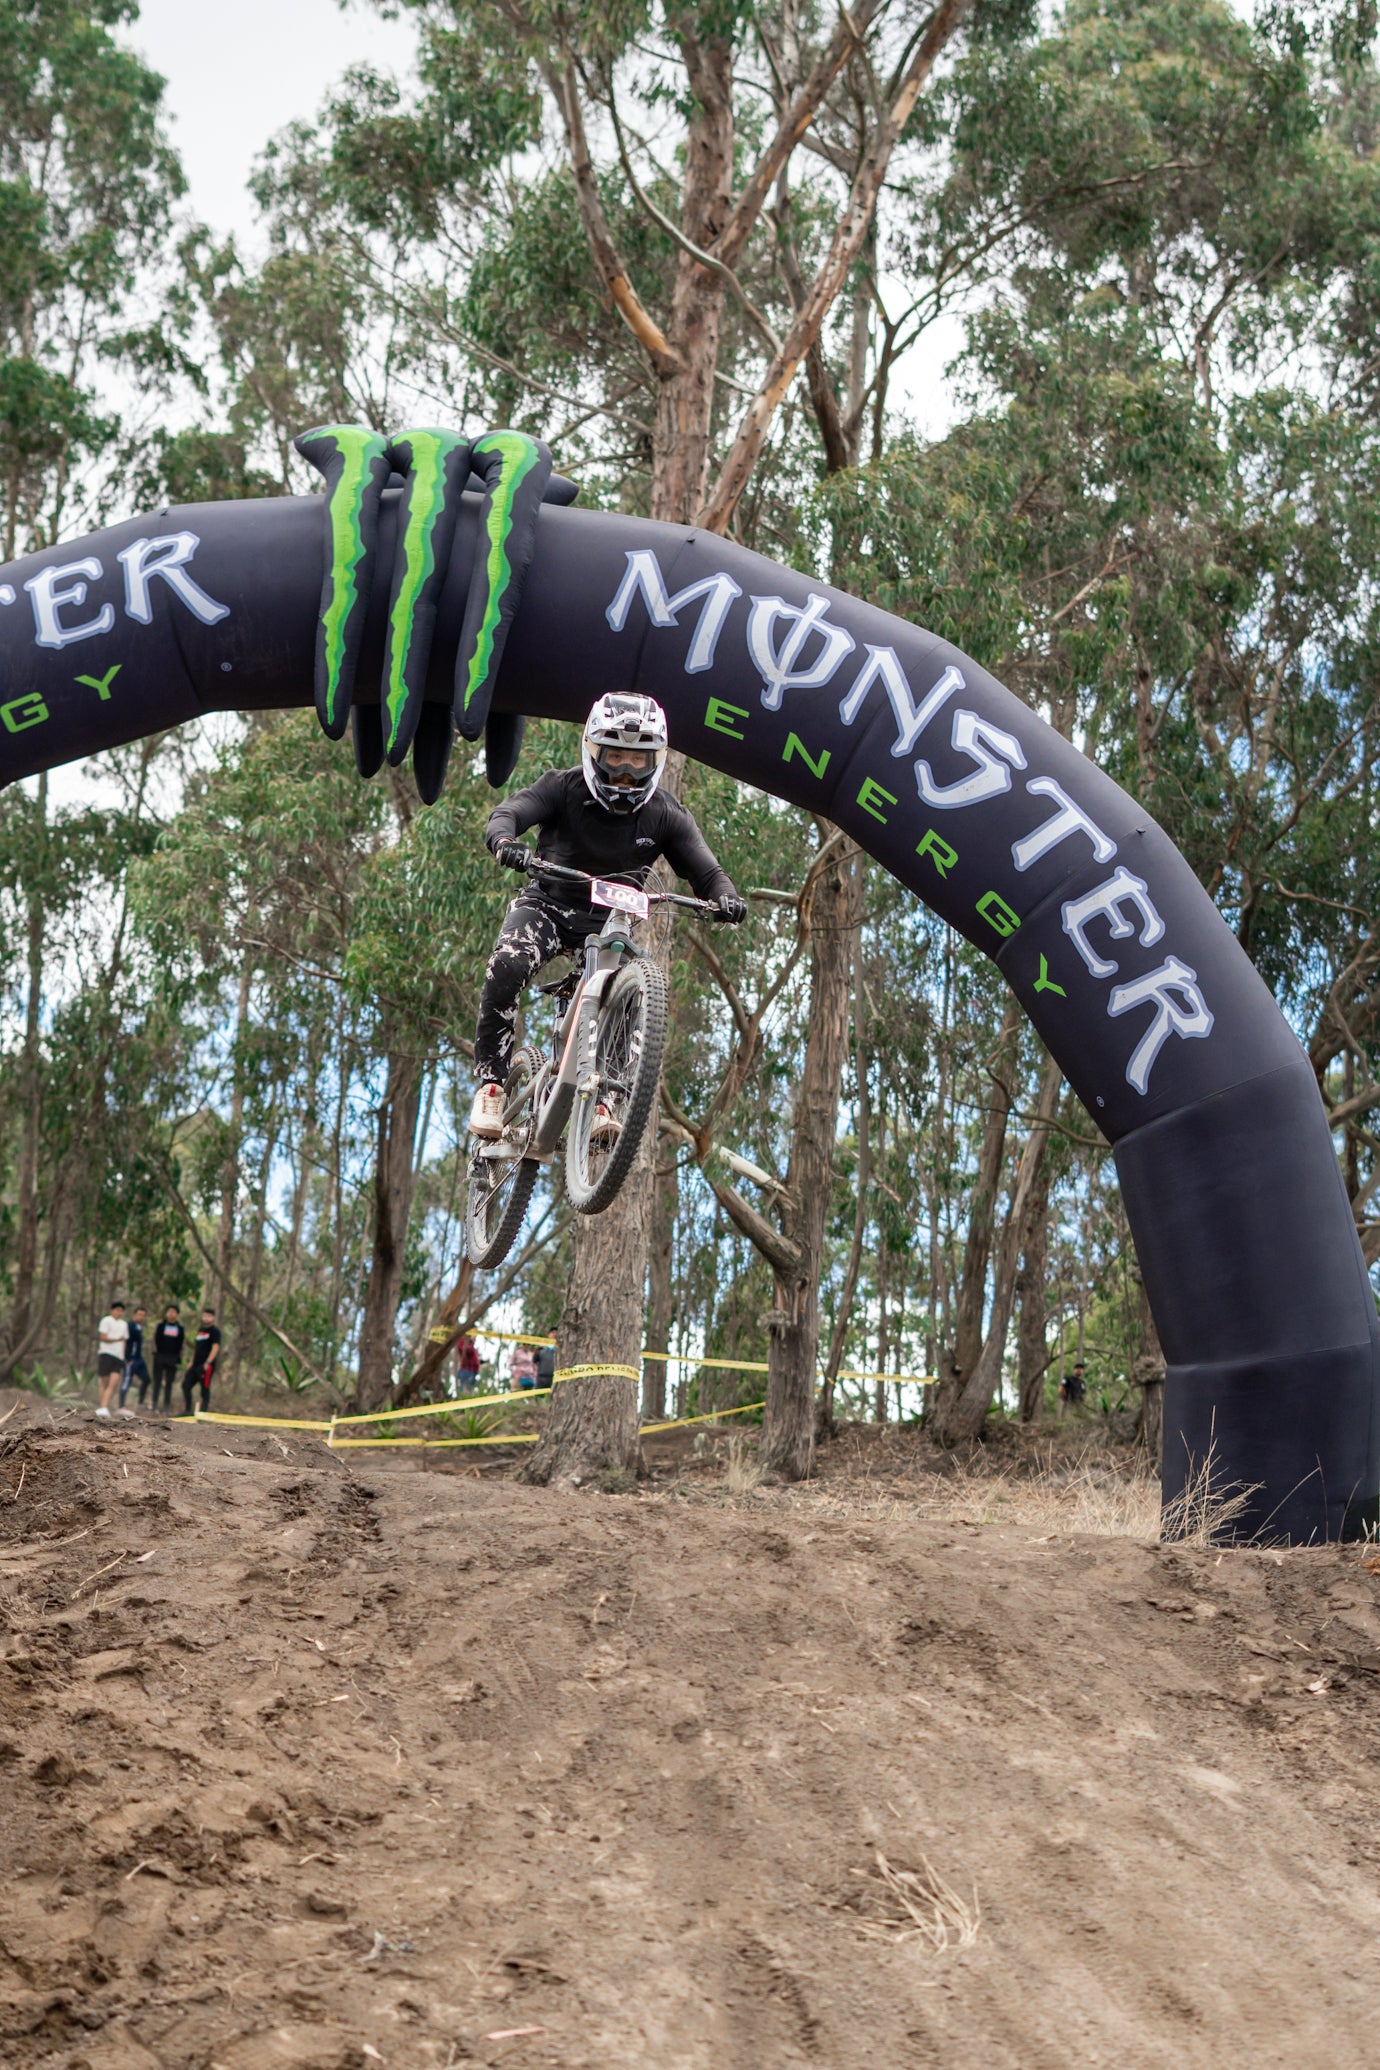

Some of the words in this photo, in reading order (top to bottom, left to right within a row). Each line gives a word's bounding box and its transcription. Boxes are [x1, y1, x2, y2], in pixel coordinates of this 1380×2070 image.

[0, 531, 230, 649] ER
[0, 664, 122, 733] GY
[605, 549, 1214, 1095] MONSTER
[704, 697, 1067, 997] ENERGY
[605, 887, 637, 905] 100
